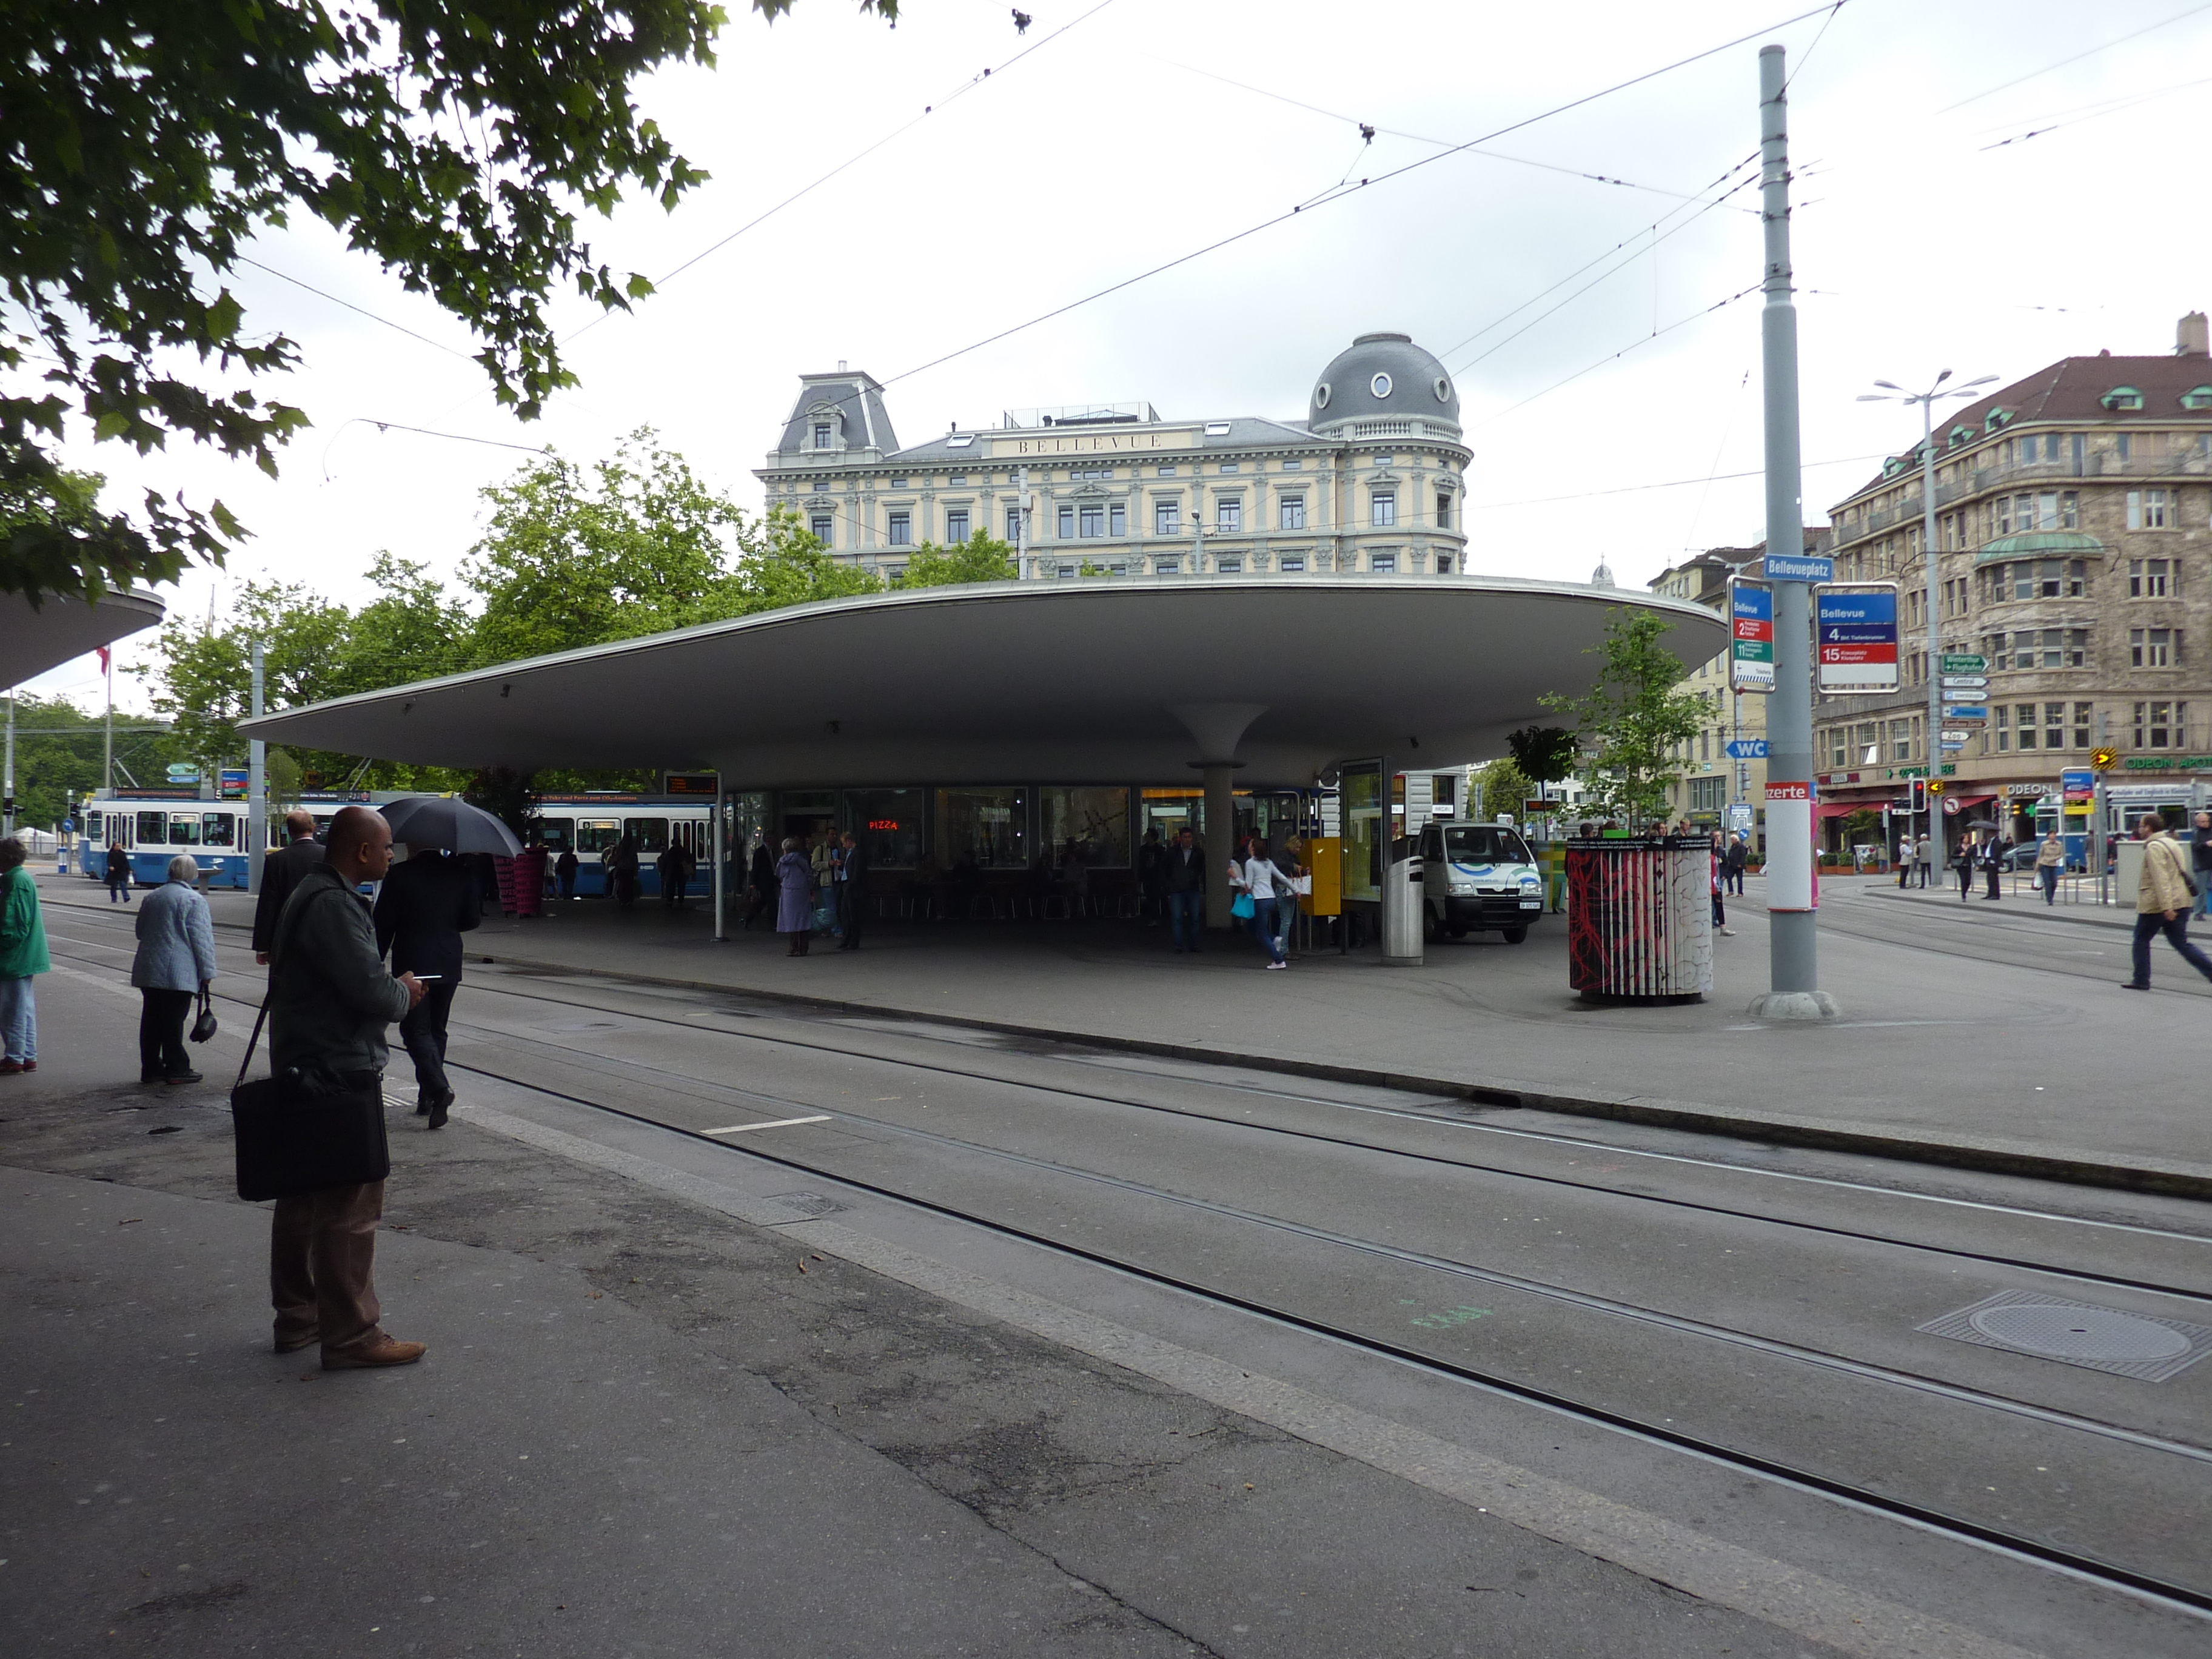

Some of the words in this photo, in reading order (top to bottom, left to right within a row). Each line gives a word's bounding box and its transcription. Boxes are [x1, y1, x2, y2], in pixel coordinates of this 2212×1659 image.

[1019, 435, 1161, 454] BELLEVUE
[1769, 560, 1829, 578] Bellevueplatz
[1734, 602, 1758, 614] Bellevue
[1821, 609, 1865, 618] Bellevue
[1739, 623, 1744, 635] 2
[1829, 628, 1839, 641] 4
[1738, 644, 1744, 657] 11
[1824, 648, 1840, 662] 15
[1952, 664, 1982, 672] Flughafen
[1736, 742, 1765, 756] WC
[2125, 757, 2173, 769] ODEON
[215, 789, 221, 799] 5
[2006, 784, 2052, 794] ODEON
[869, 820, 897, 830] PIZZA
